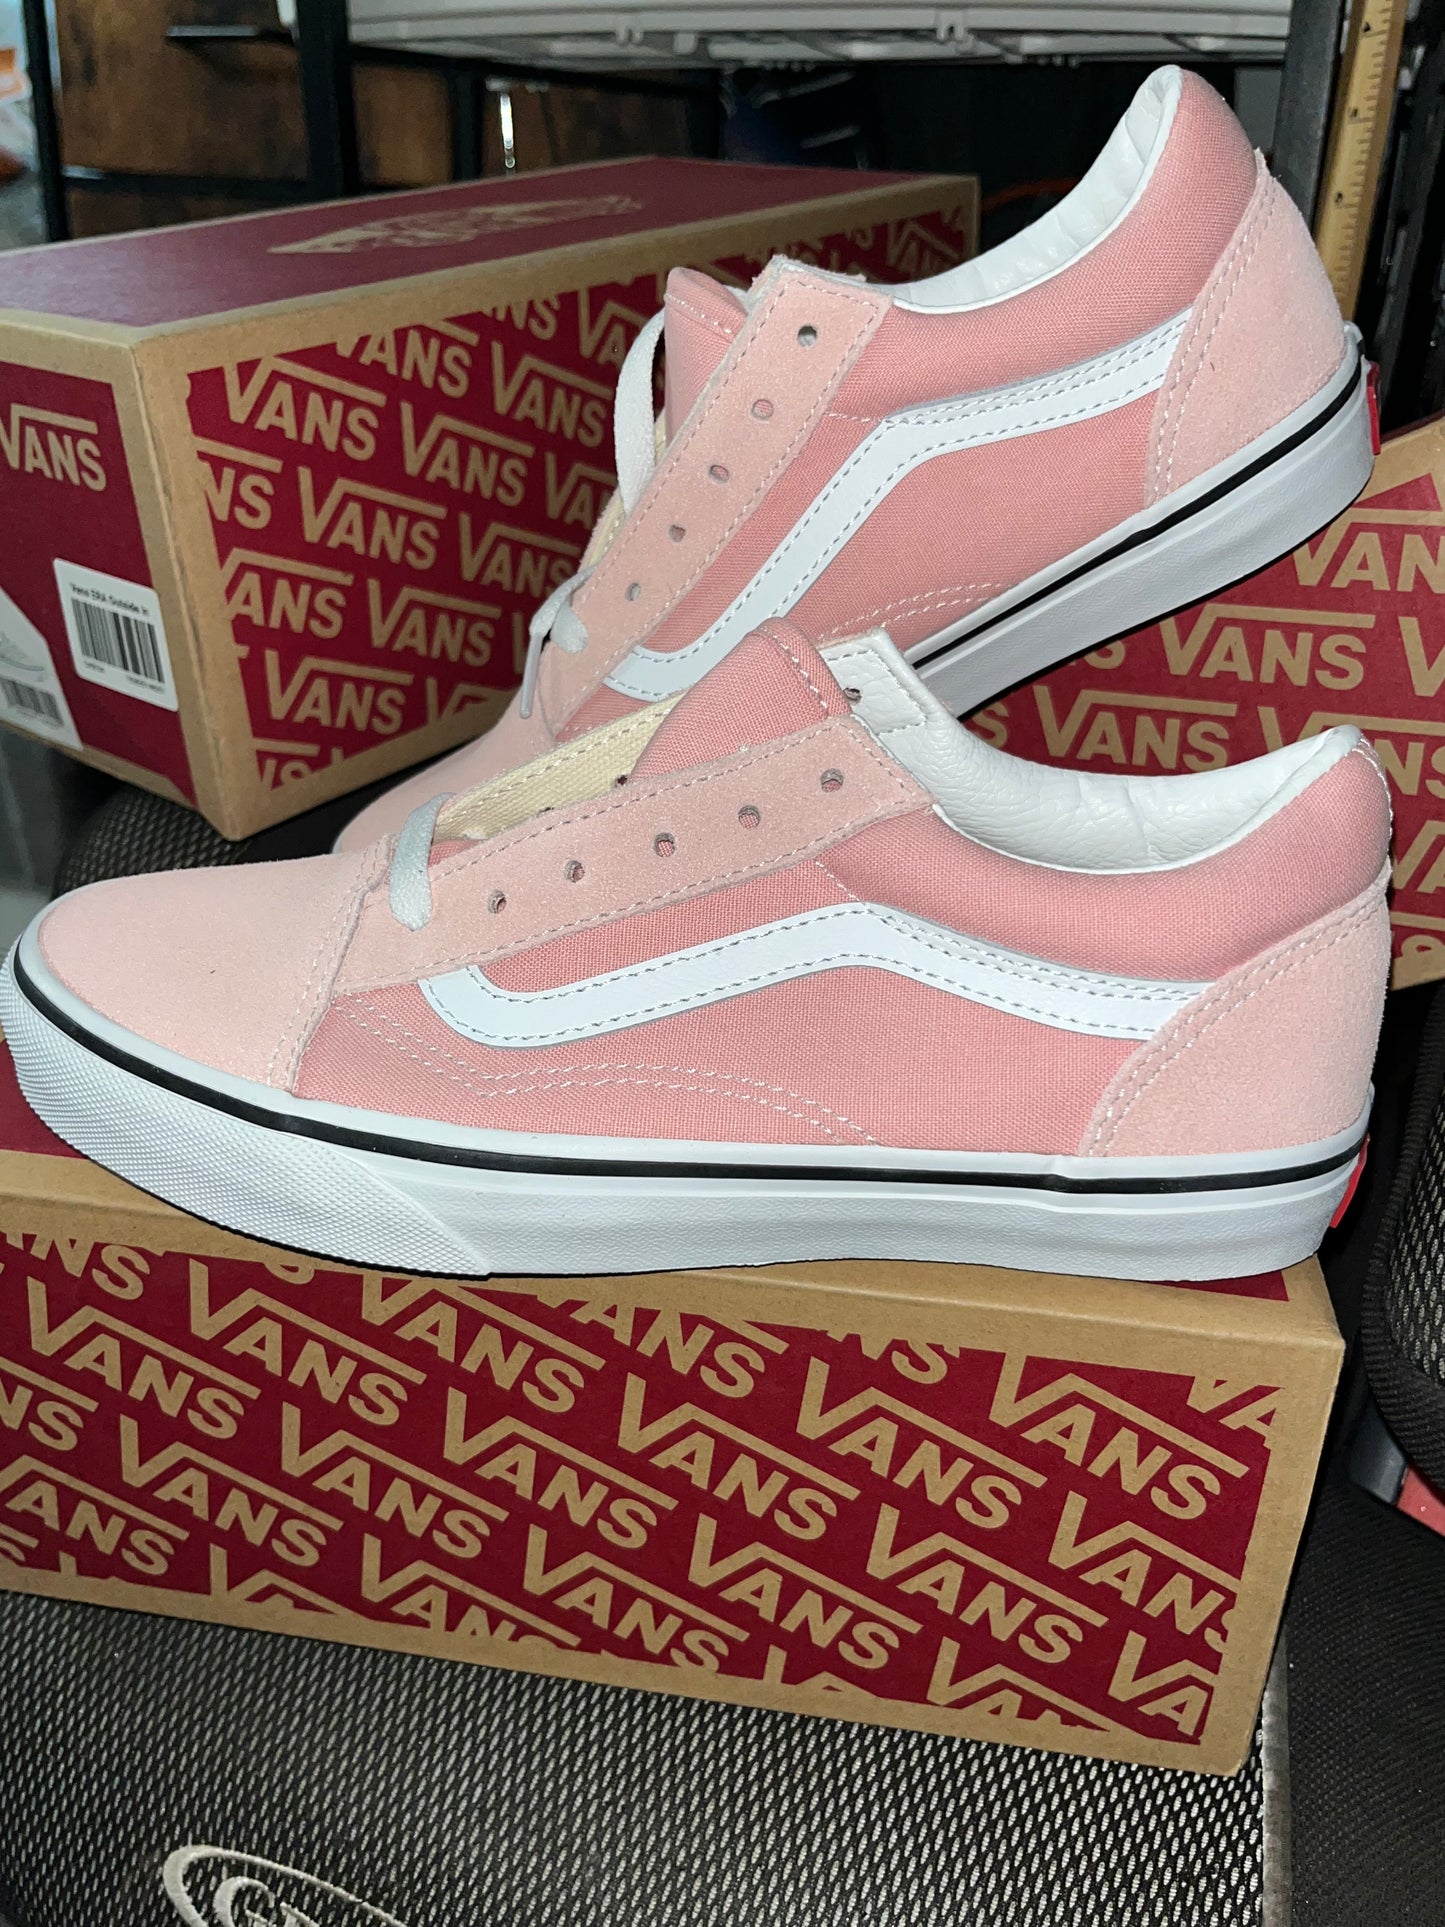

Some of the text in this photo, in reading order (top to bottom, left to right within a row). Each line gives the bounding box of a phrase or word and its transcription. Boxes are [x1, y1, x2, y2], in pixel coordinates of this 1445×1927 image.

[223, 356, 387, 462] VANS
[336, 321, 479, 399] ANS
[491, 341, 613, 448] VANS
[0, 402, 107, 492] VANS
[401, 401, 536, 507] VANS
[298, 465, 448, 570] VANS
[1292, 507, 1445, 594] VAN
[368, 577, 502, 667] VANS
[1158, 603, 1376, 691] VANS
[265, 648, 415, 735] VANS
[1033, 684, 1238, 774] VANS
[27, 1276, 262, 1439] VANS
[188, 1258, 428, 1426] VANS
[361, 1273, 607, 1413] VANS
[537, 1295, 790, 1398] ANS
[119, 1413, 344, 1567] VANS
[281, 1401, 510, 1559] VANS
[443, 1386, 680, 1549] VANS
[617, 1372, 862, 1540] VANS
[796, 1355, 1049, 1529] VANS
[989, 1353, 1250, 1520] VANS
[523, 1524, 750, 1673] VANS
[688, 1513, 924, 1669] VANS
[866, 1502, 1110, 1663] VANS
[1108, 1630, 1220, 1737] VA
